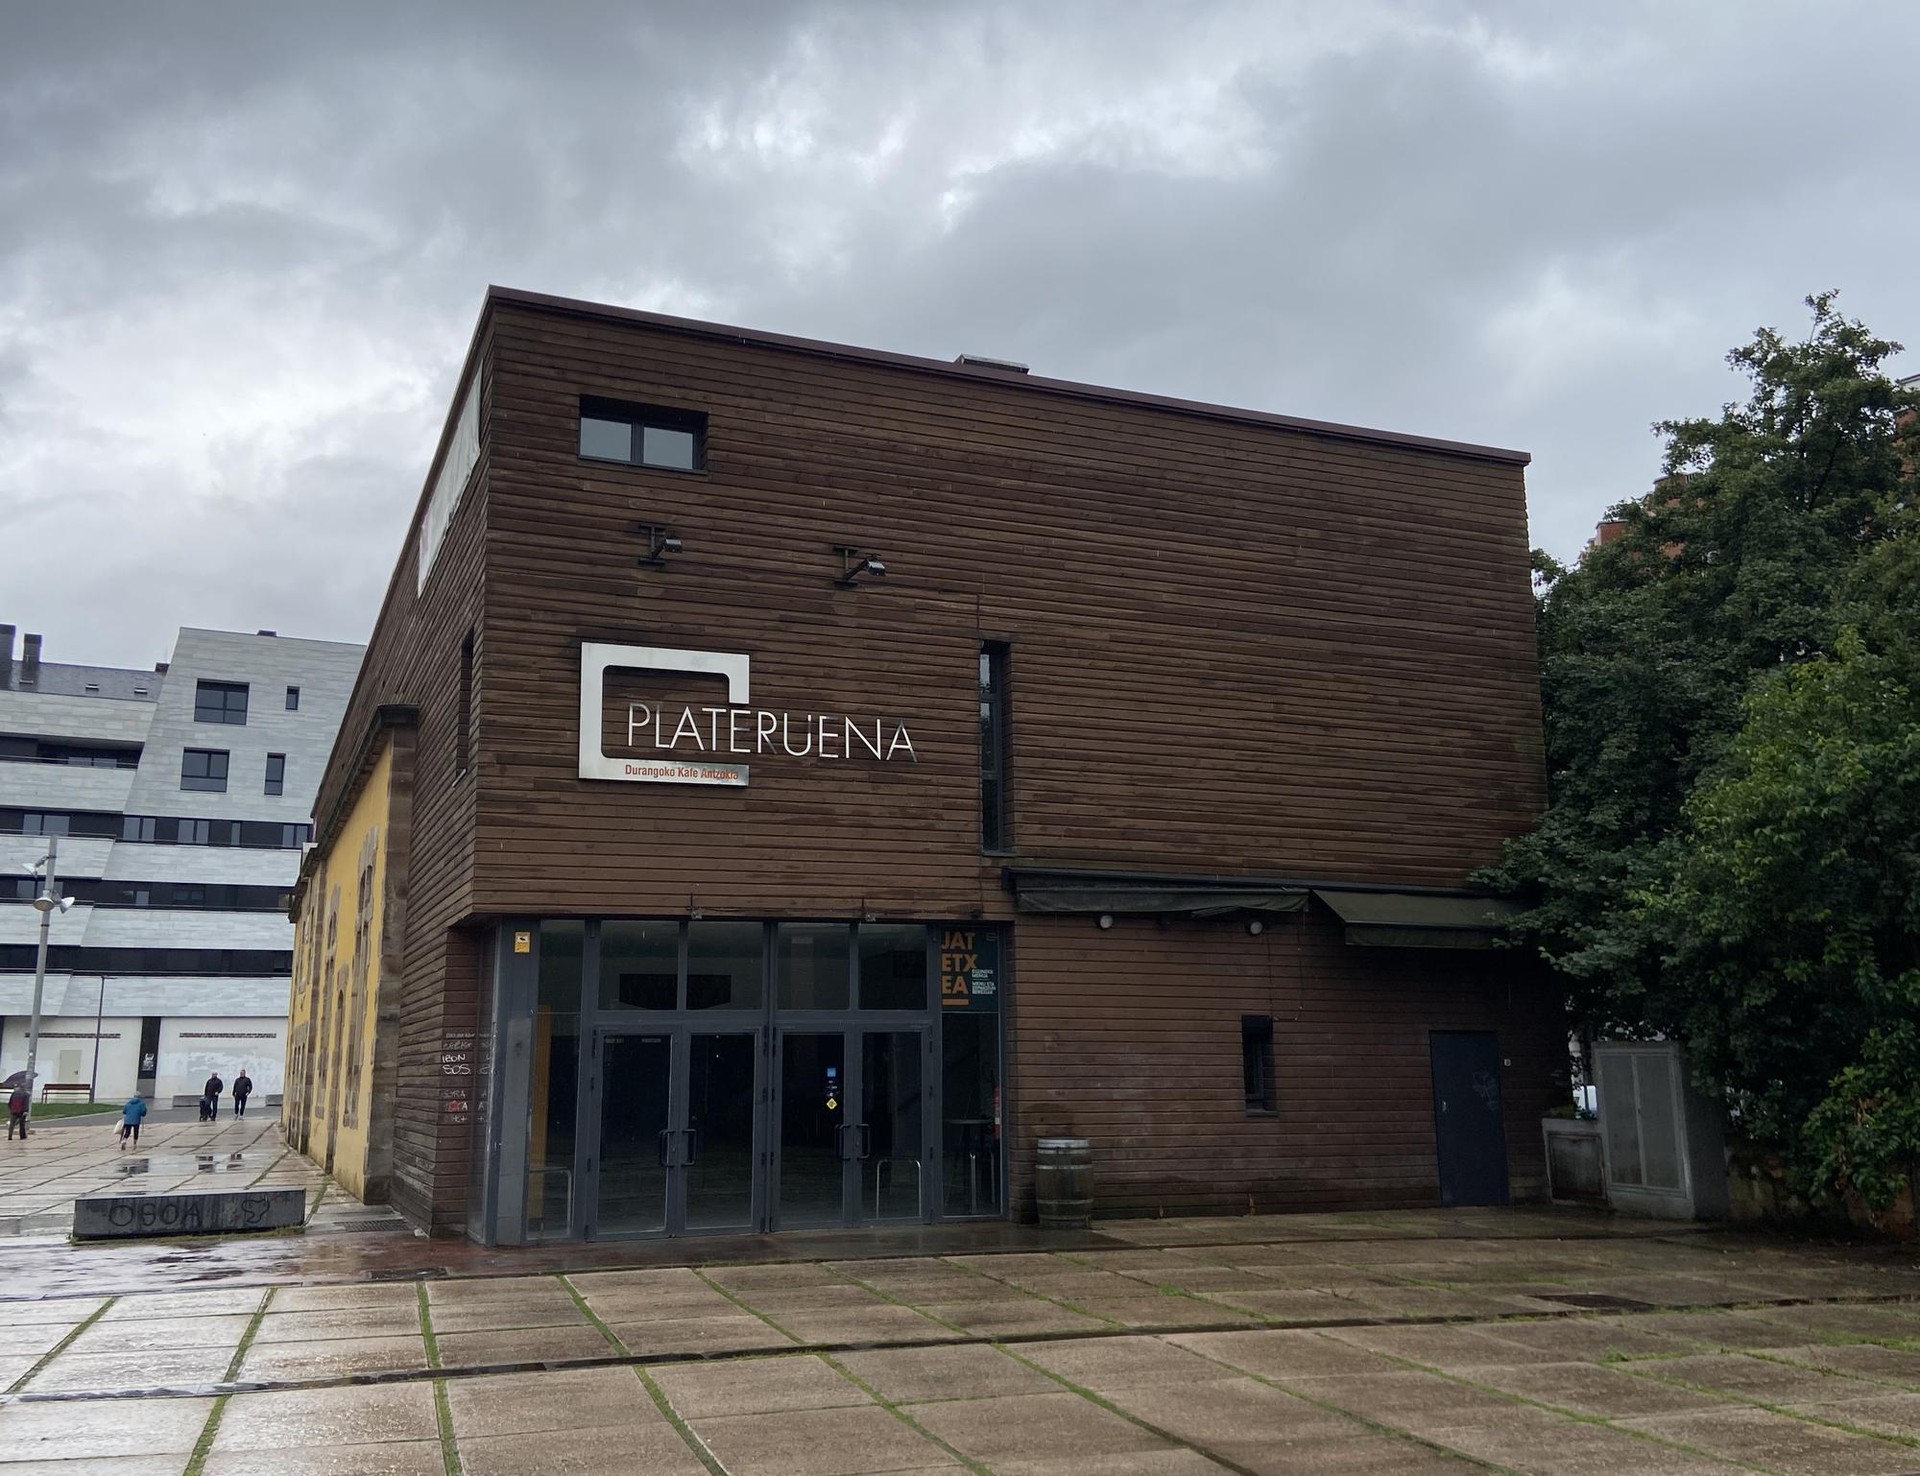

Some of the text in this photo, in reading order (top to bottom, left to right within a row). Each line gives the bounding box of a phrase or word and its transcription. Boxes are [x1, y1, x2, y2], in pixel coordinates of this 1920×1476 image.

[628, 703, 918, 763] PLATERUENA
[625, 764, 676, 778] Durangoko
[677, 767, 699, 778] Kafe
[941, 931, 976, 950] JAT
[941, 953, 978, 972] ETX
[941, 976, 969, 994] EA
